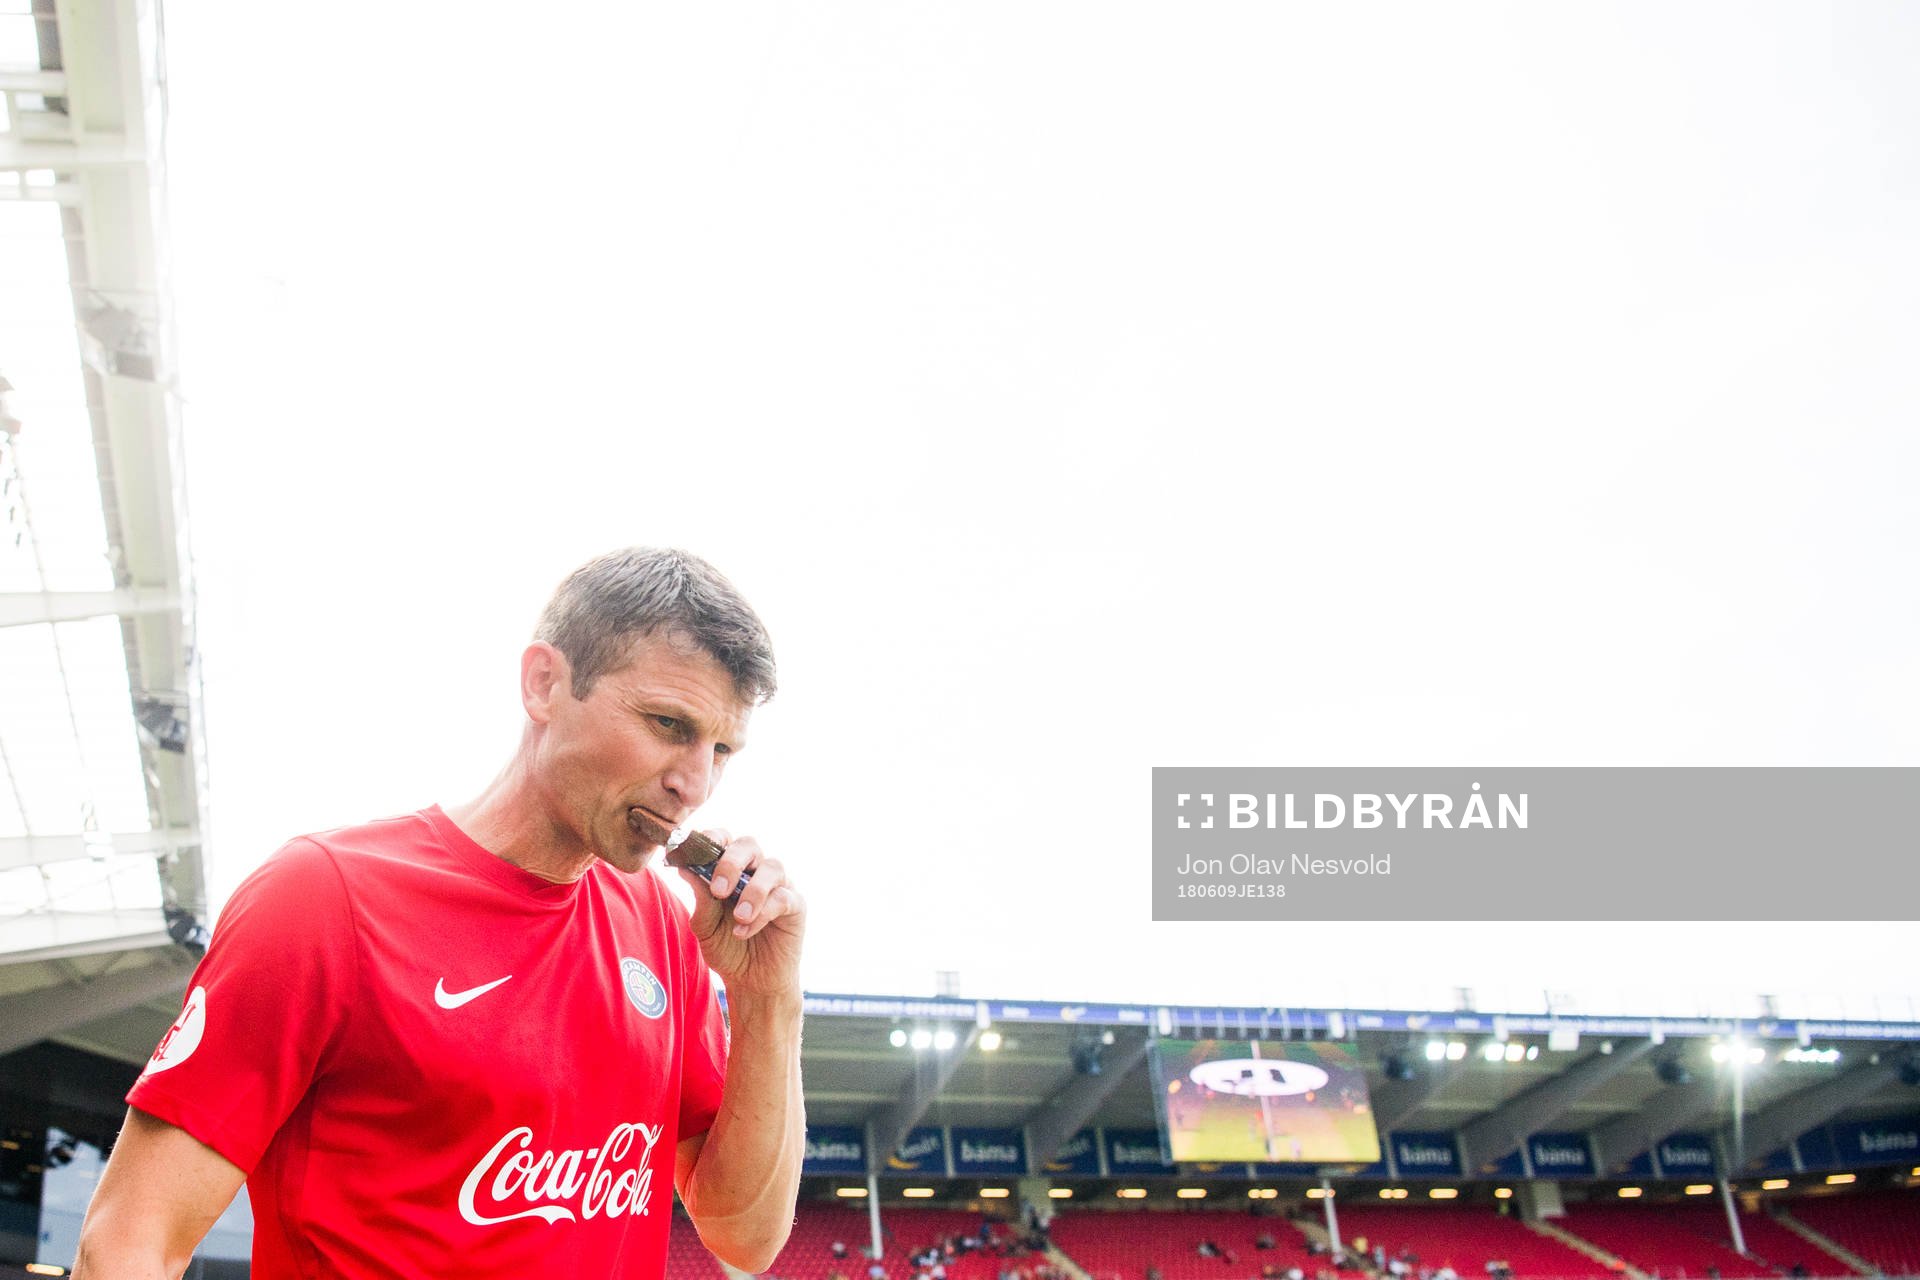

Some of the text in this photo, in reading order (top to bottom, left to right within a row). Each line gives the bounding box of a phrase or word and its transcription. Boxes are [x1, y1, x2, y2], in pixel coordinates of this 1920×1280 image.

[961, 1139, 1017, 1163] bama
[1114, 1141, 1162, 1164] bam
[458, 1122, 664, 1226] Coca-Cola
